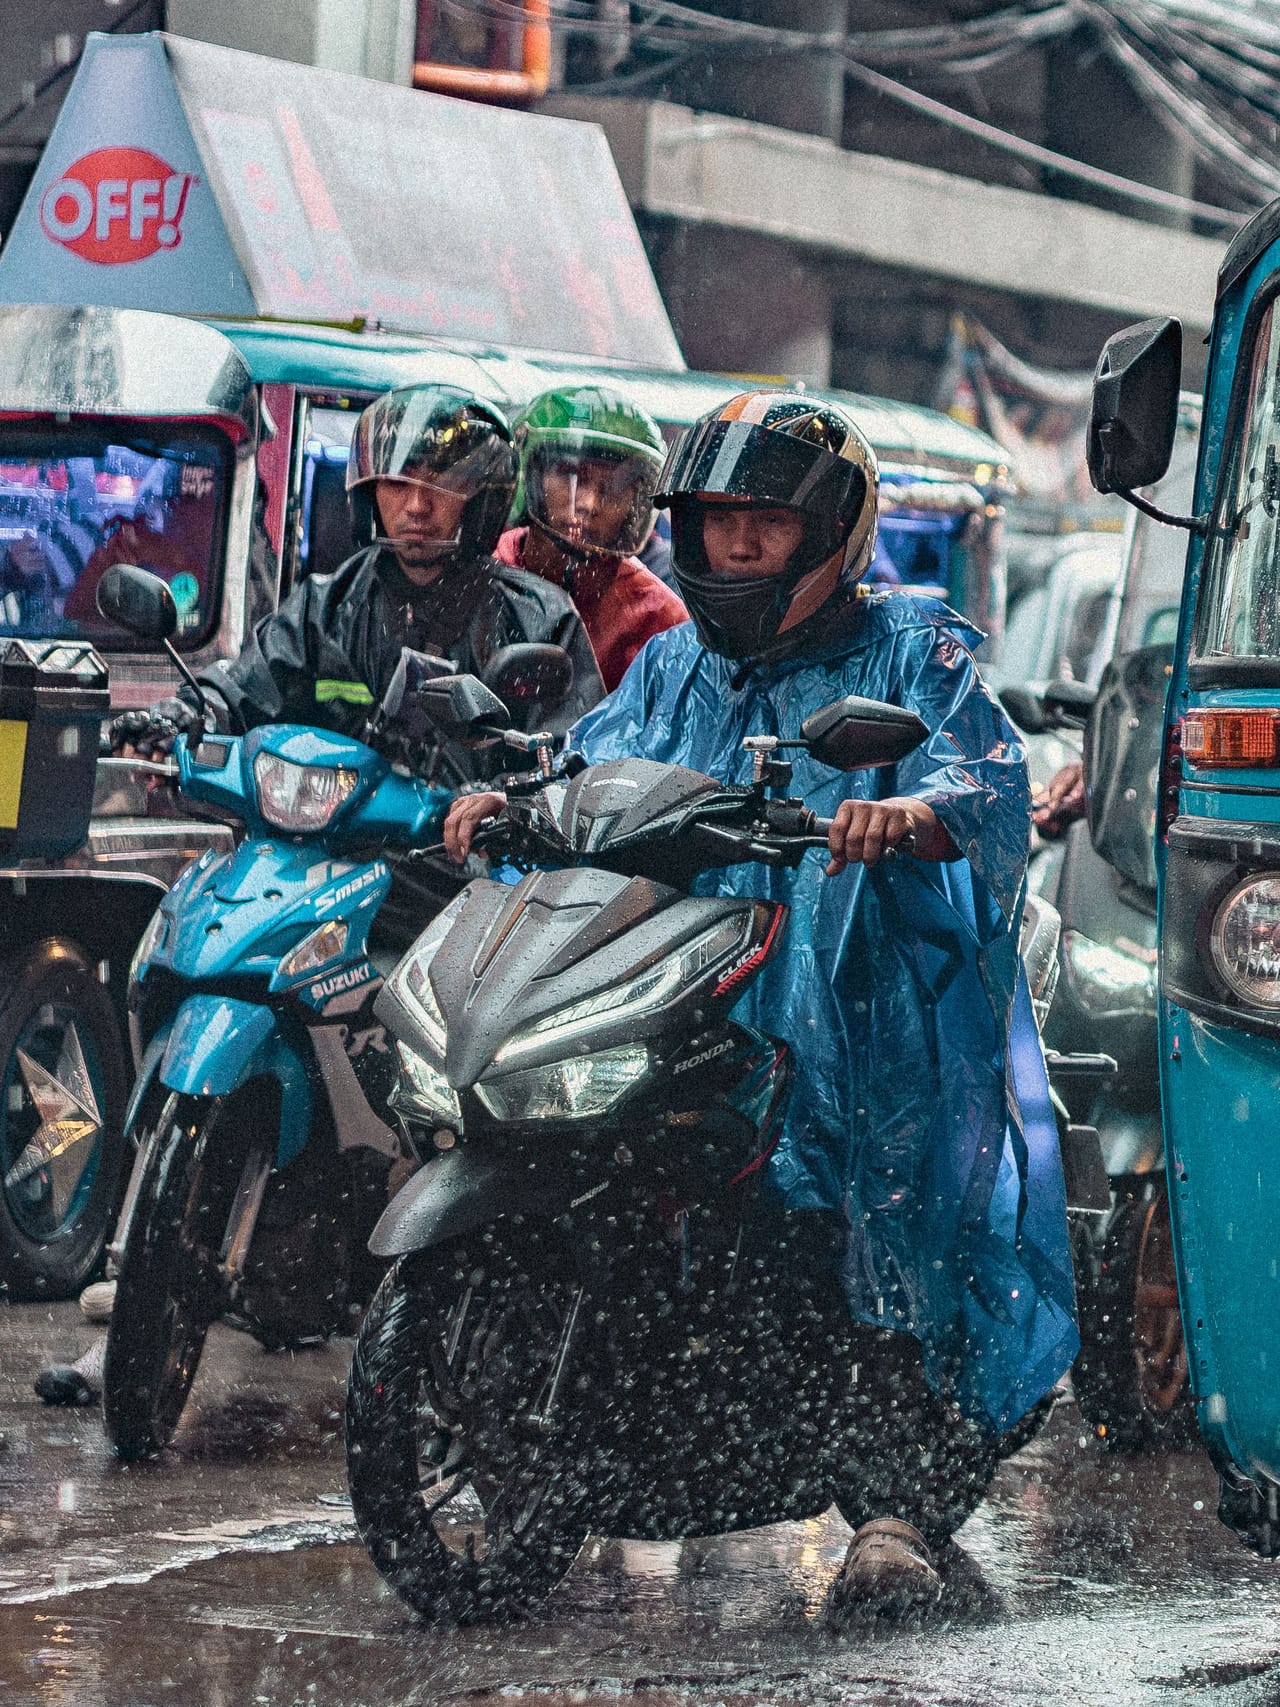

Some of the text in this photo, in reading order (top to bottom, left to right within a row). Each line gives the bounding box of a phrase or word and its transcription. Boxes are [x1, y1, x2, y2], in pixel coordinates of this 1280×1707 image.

[41, 173, 191, 249] OFF!
[314, 862, 386, 919] Smash
[310, 962, 370, 1000] SUZUKI
[718, 942, 762, 983] CLICK
[672, 1038, 735, 1075] HONDA
